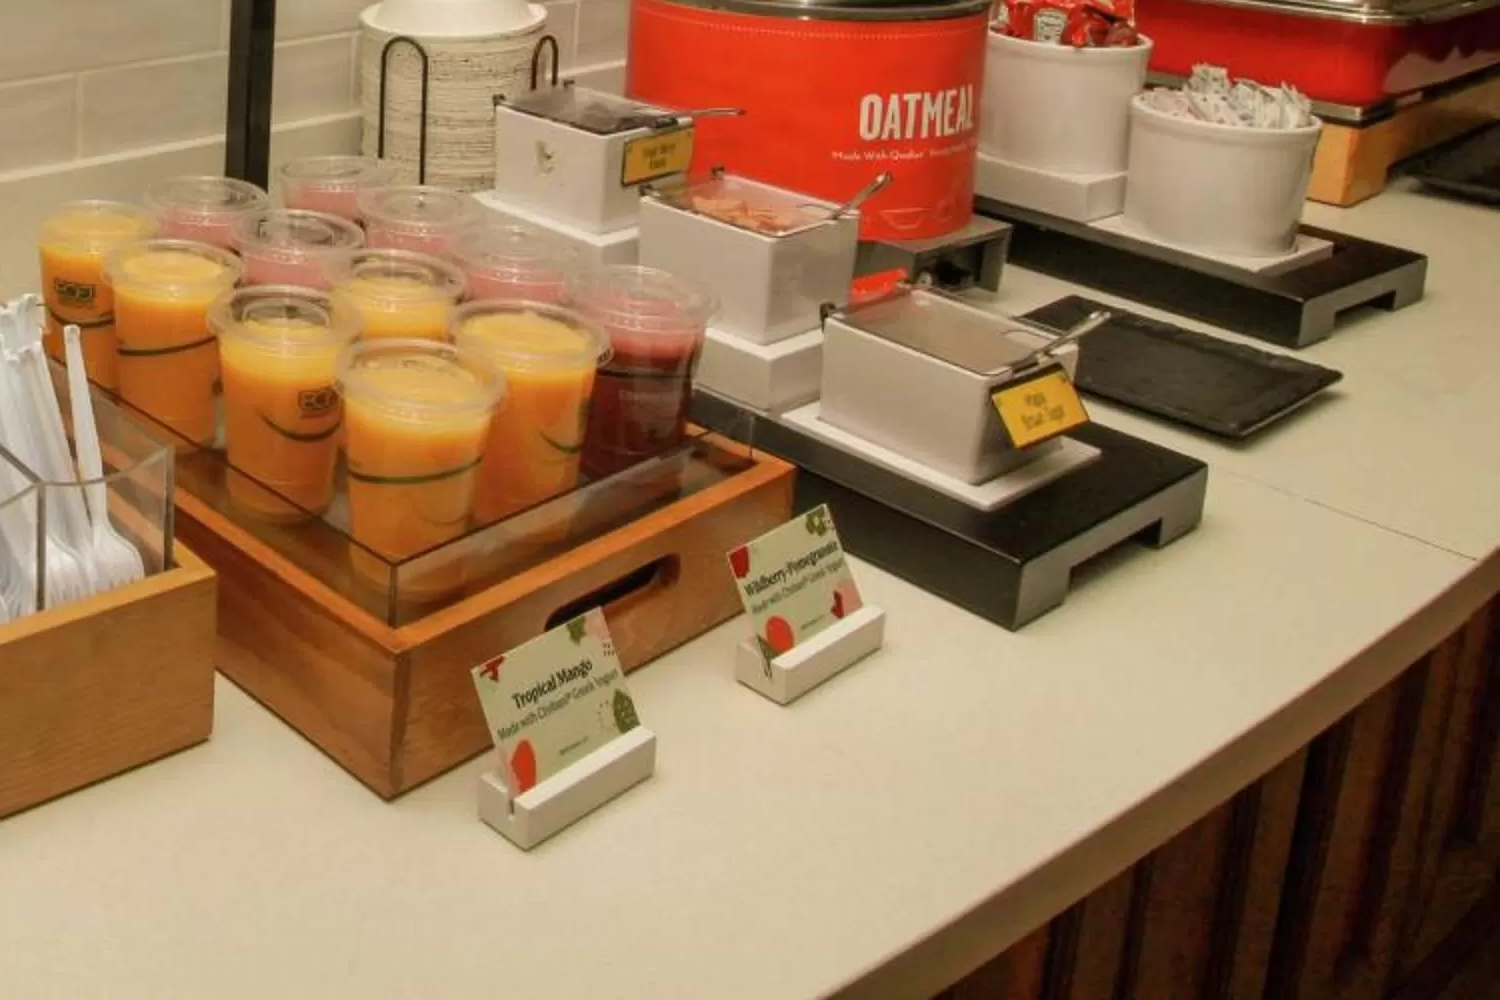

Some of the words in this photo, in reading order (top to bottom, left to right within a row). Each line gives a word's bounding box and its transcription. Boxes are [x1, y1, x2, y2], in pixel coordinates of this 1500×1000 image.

[858, 83, 974, 142] OATMEAL
[512, 673, 557, 710] Tropical
[555, 658, 593, 686] Mango
